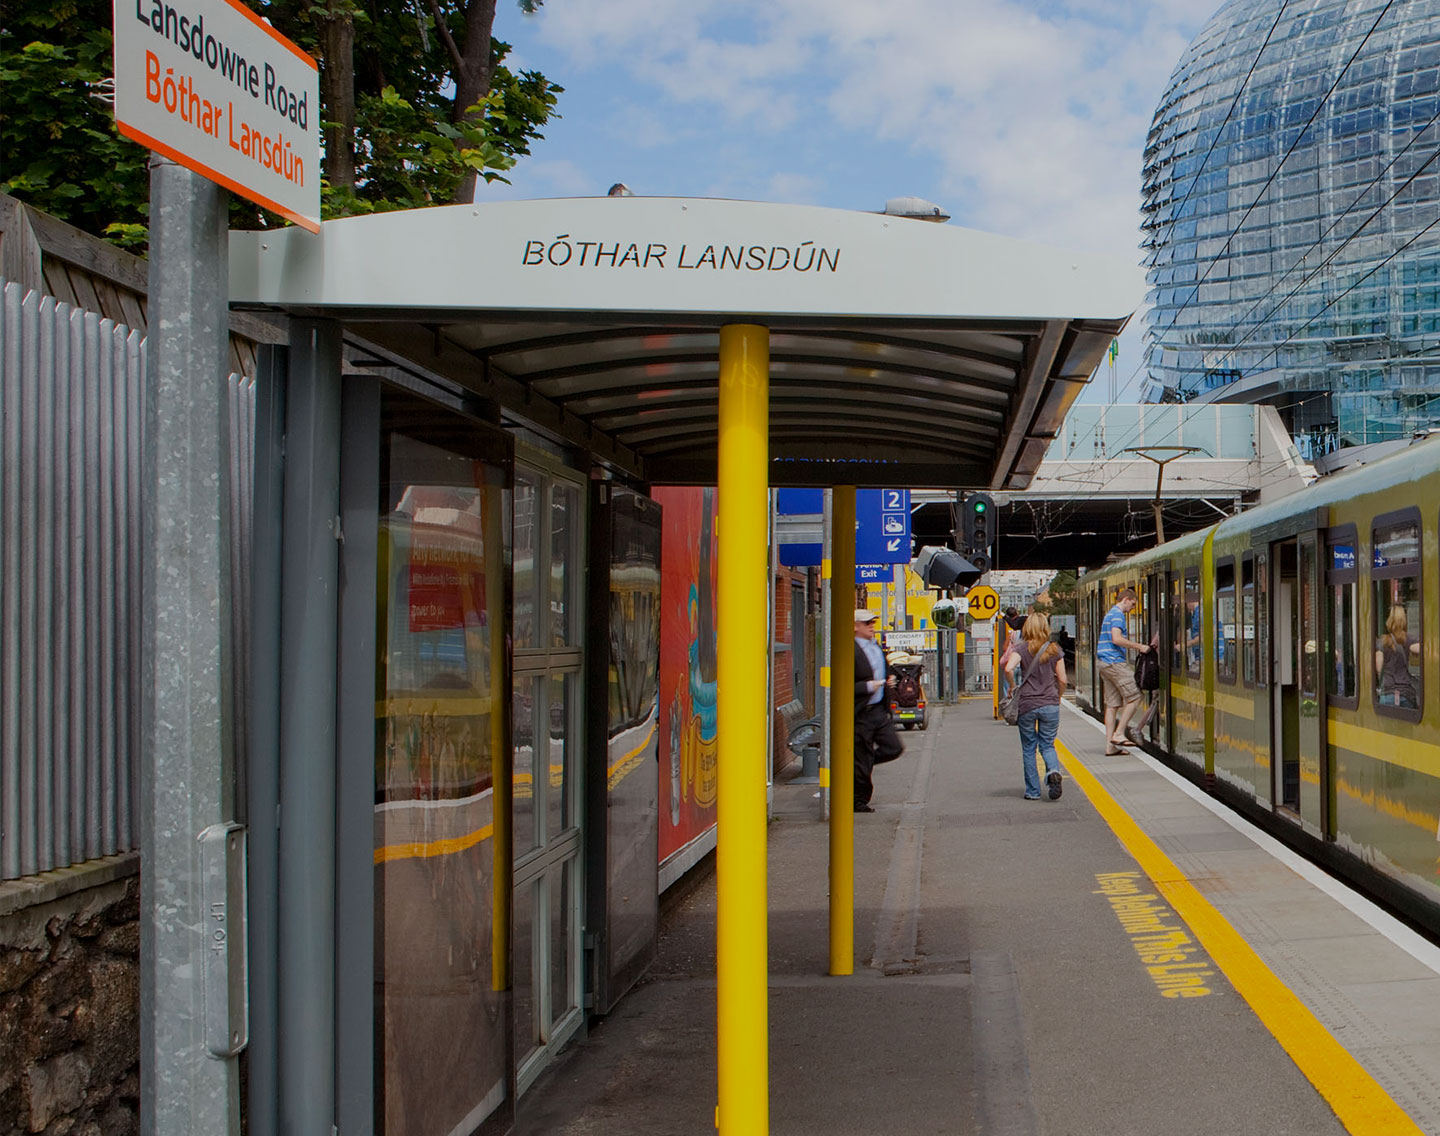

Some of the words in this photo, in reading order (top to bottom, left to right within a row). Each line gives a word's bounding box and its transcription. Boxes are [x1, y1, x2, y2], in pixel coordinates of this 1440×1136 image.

[264, 62, 308, 131] Road
[146, 49, 222, 138] Bóthar
[228, 102, 304, 187] Lansdún
[522, 234, 667, 268] BÓTHAR
[677, 241, 841, 272] LANSDÚN
[888, 491, 900, 508] 2
[861, 570, 878, 578] Exit
[969, 594, 997, 610] 40
[1092, 871, 1142, 895] Keep
[1130, 930, 1198, 964] This
[1146, 962, 1215, 999] Line
